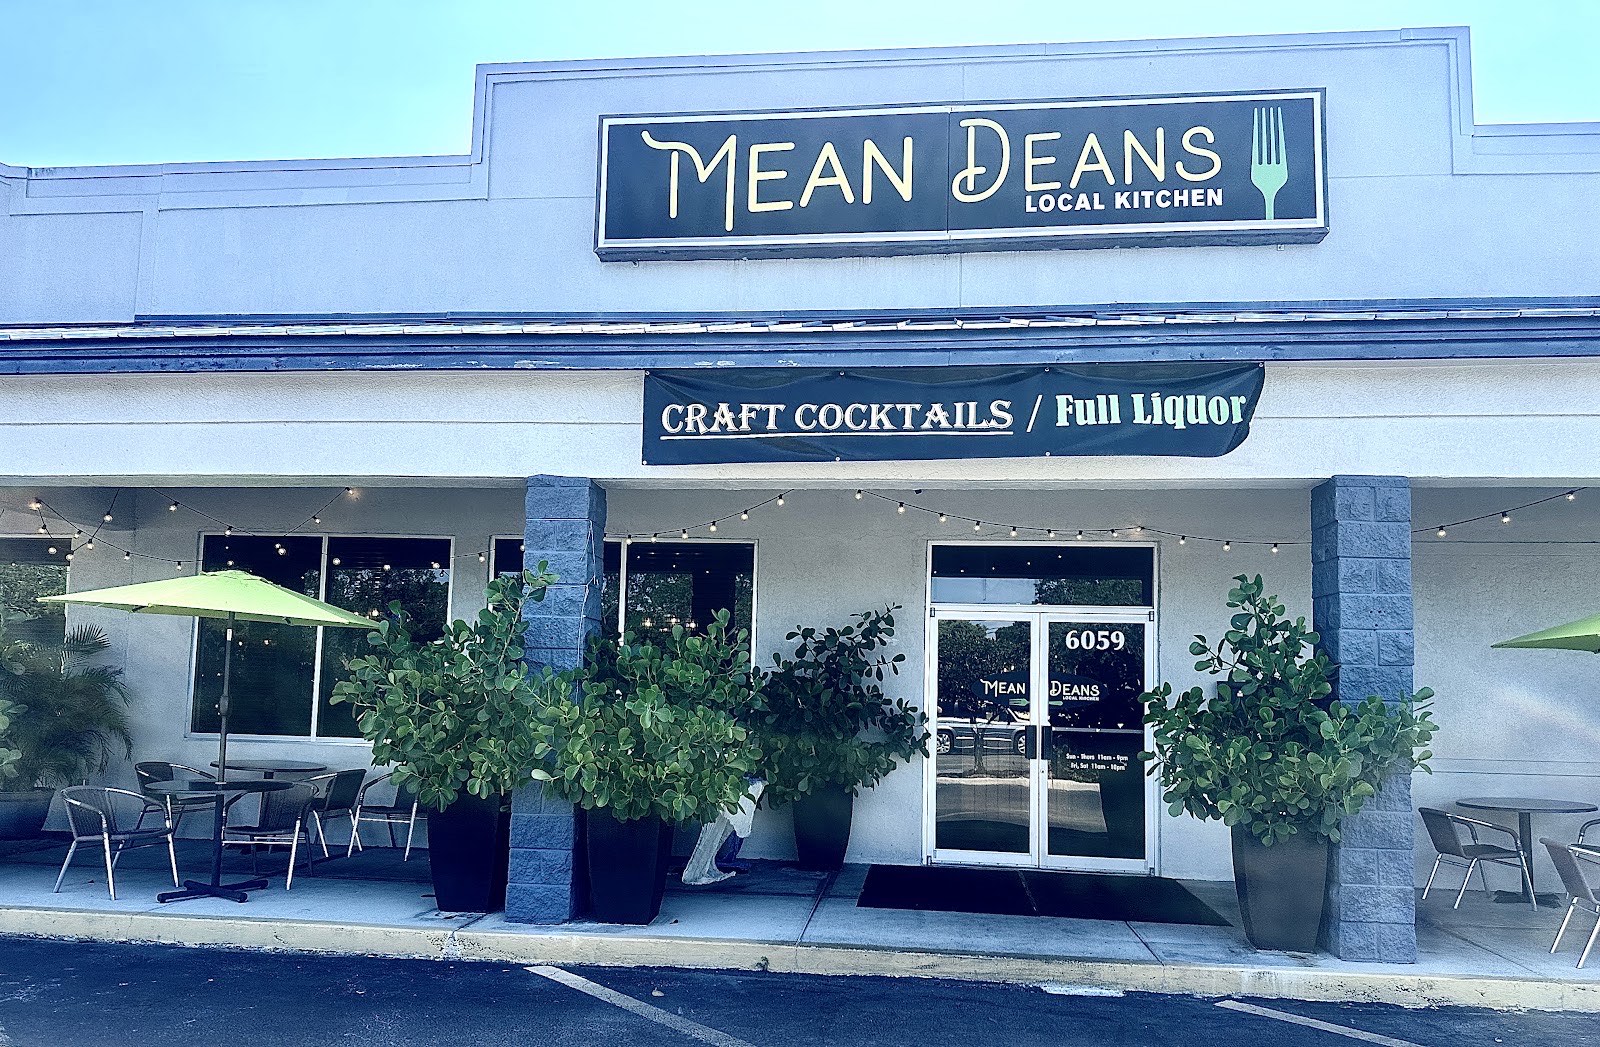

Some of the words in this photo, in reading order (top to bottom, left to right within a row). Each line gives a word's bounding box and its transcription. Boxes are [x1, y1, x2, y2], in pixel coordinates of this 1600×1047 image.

[641, 130, 913, 232] MEAN
[951, 118, 1222, 203] DEANS
[1025, 192, 1105, 213] LOCAL
[1114, 188, 1223, 209] KITCHEN
[661, 402, 786, 435] CRAFT
[794, 399, 1014, 431] COCKTAILS
[1055, 394, 1121, 427] Full
[1130, 392, 1247, 430] Liquor
[1065, 629, 1125, 651] 6059
[980, 678, 1026, 697] MEAN
[1049, 680, 1100, 697] DEANS
